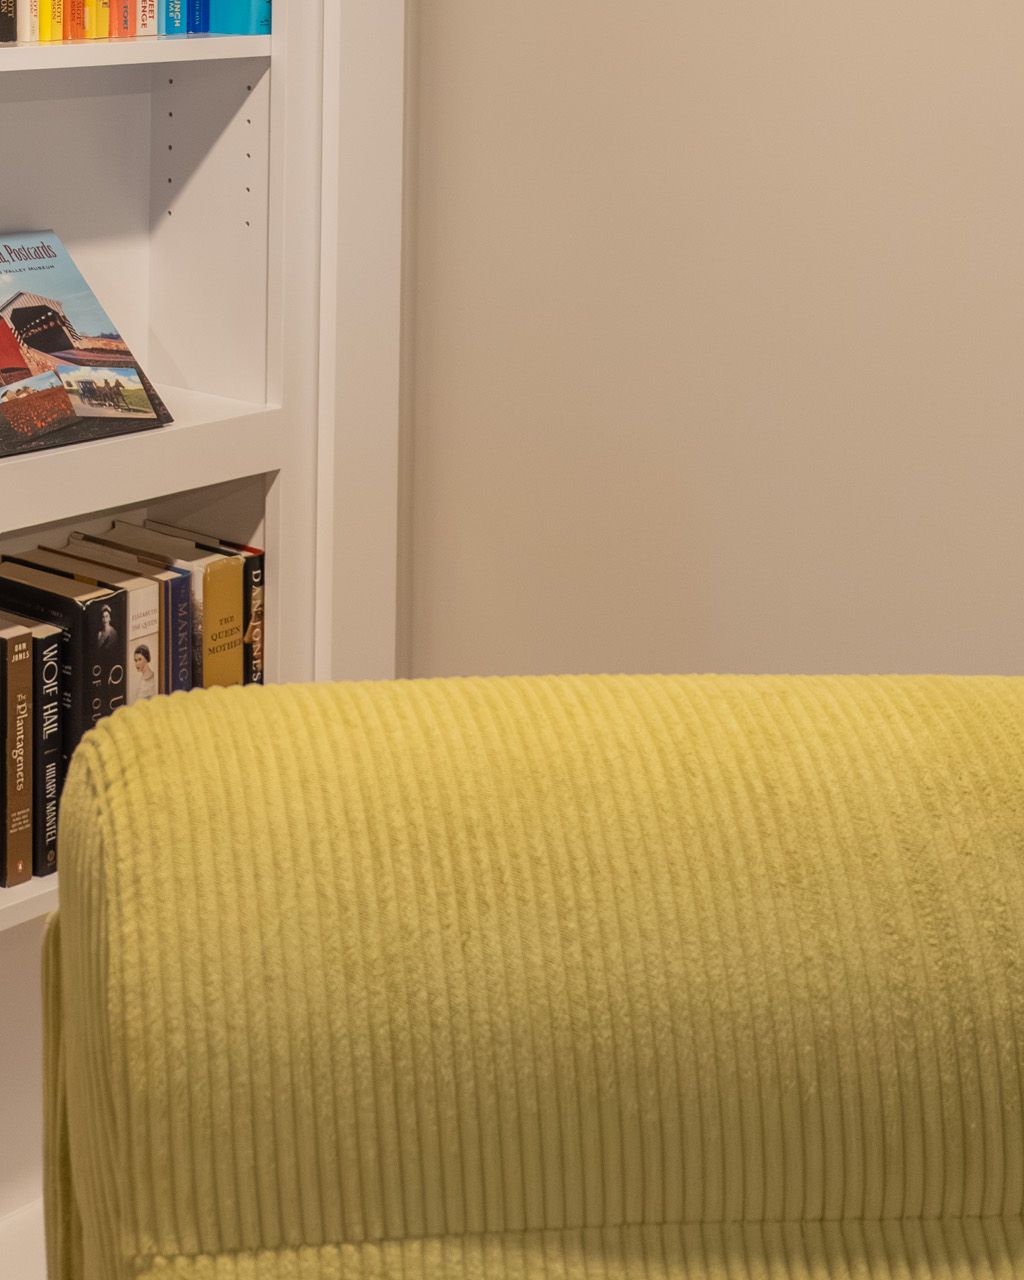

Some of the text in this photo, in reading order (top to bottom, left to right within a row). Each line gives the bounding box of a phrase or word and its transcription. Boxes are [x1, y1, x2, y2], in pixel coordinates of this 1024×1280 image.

[5, 241, 57, 261] Postcards
[28, 264, 55, 272] MUSEUM
[219, 615, 234, 625] THE
[252, 570, 262, 681] DAN JONES
[178, 602, 188, 682] MAKING
[211, 626, 240, 641] QUEEN
[12, 651, 30, 662] JONES
[92, 665, 101, 687] OF
[42, 643, 58, 739] WOLF HALL
[12, 702, 27, 791] Plantagenets
[46, 763, 56, 845] HILARY MANTEL
